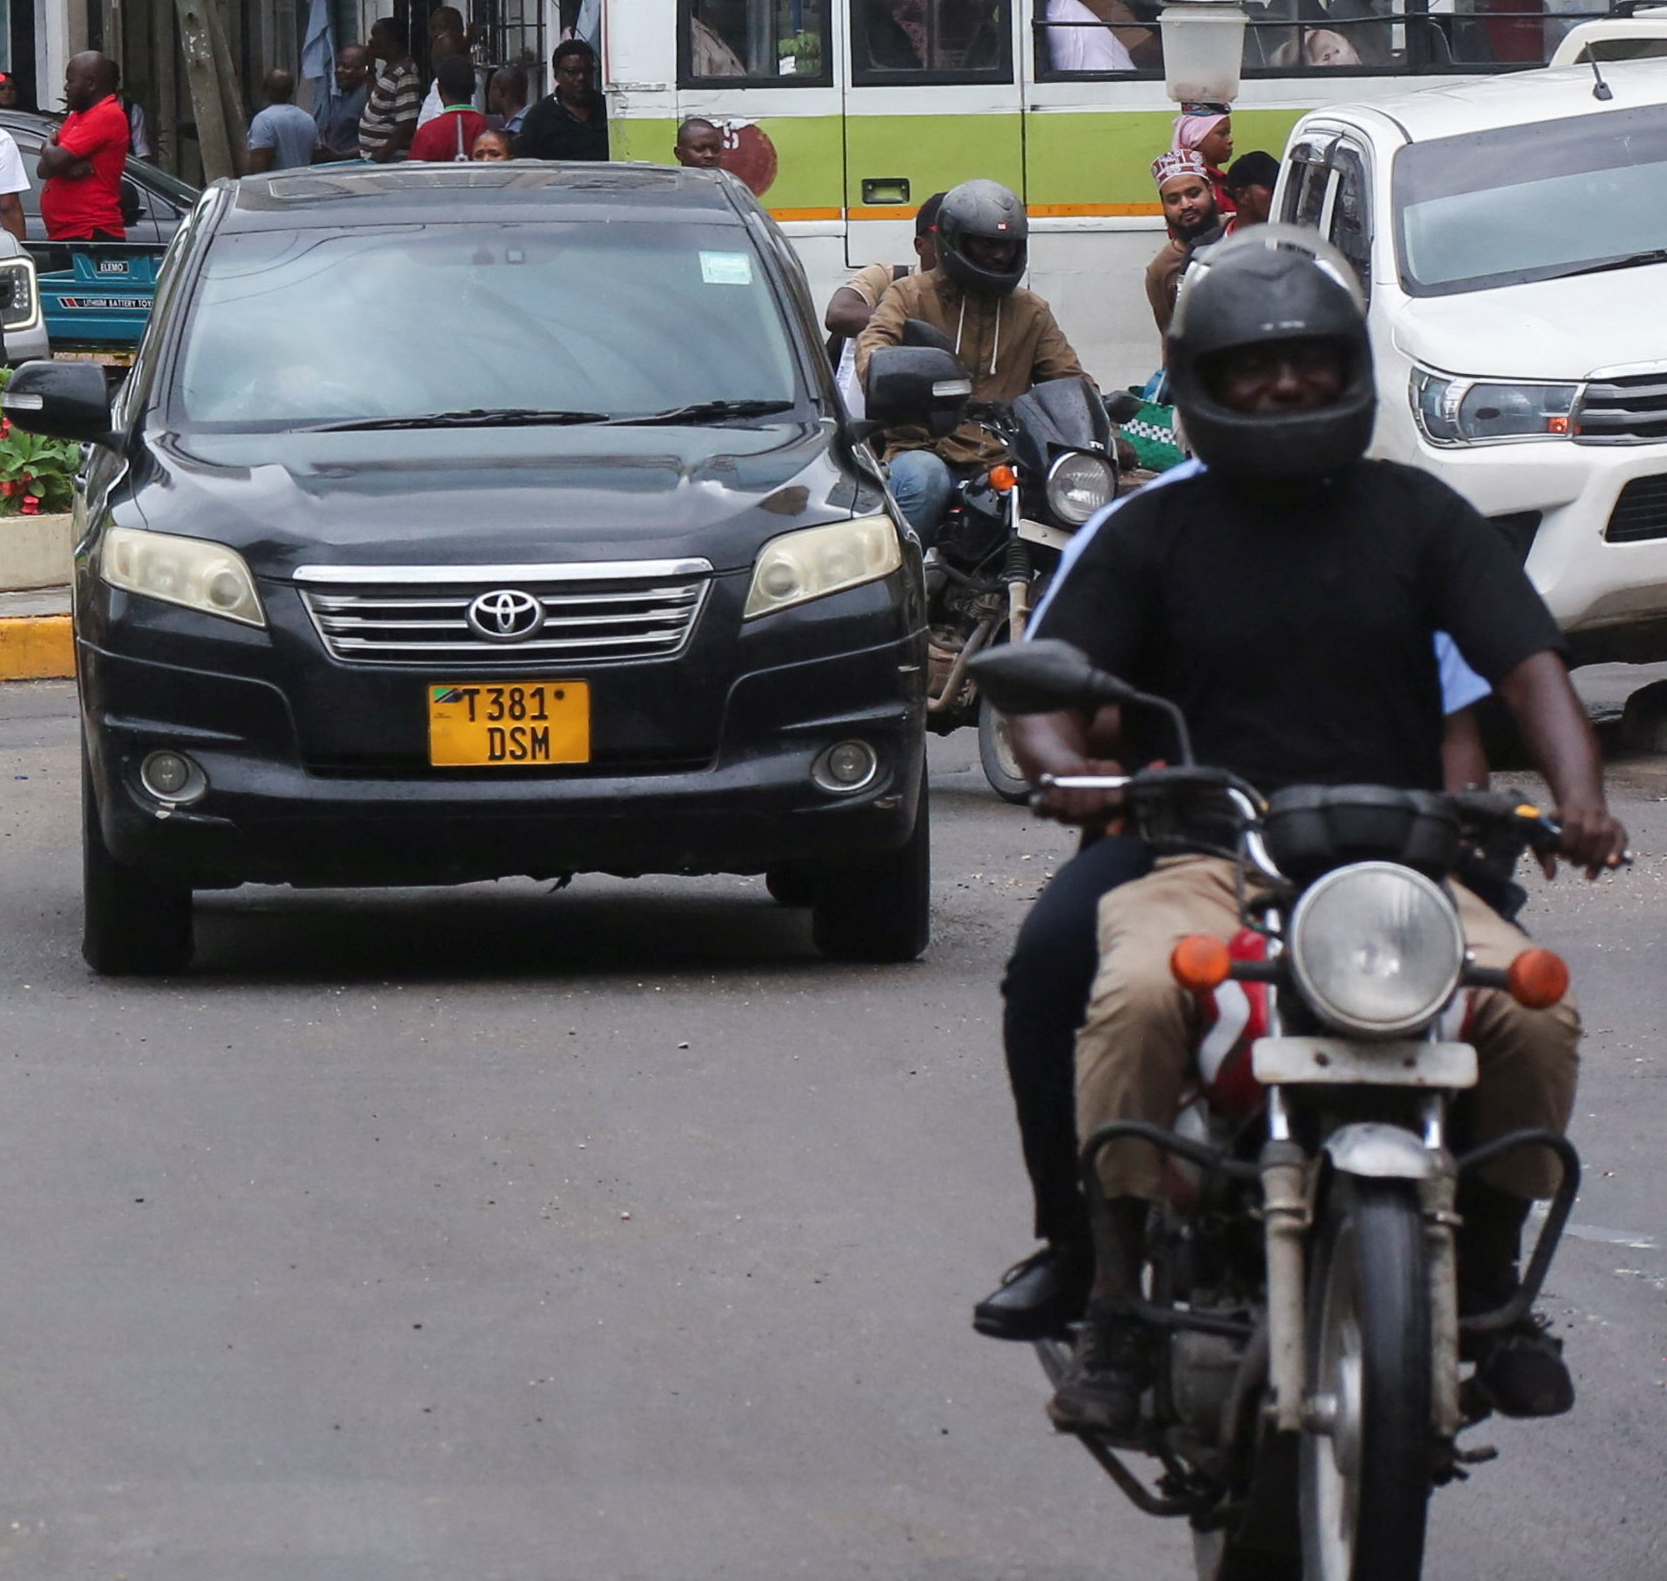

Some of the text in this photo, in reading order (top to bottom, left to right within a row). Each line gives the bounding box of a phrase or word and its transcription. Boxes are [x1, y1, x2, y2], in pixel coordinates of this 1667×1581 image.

[100, 263, 125, 272] ELEMO
[83, 299, 107, 308] LITHIUM
[108, 300, 137, 309] BATTERY
[462, 687, 549, 722] T381
[487, 725, 551, 761] DSM
